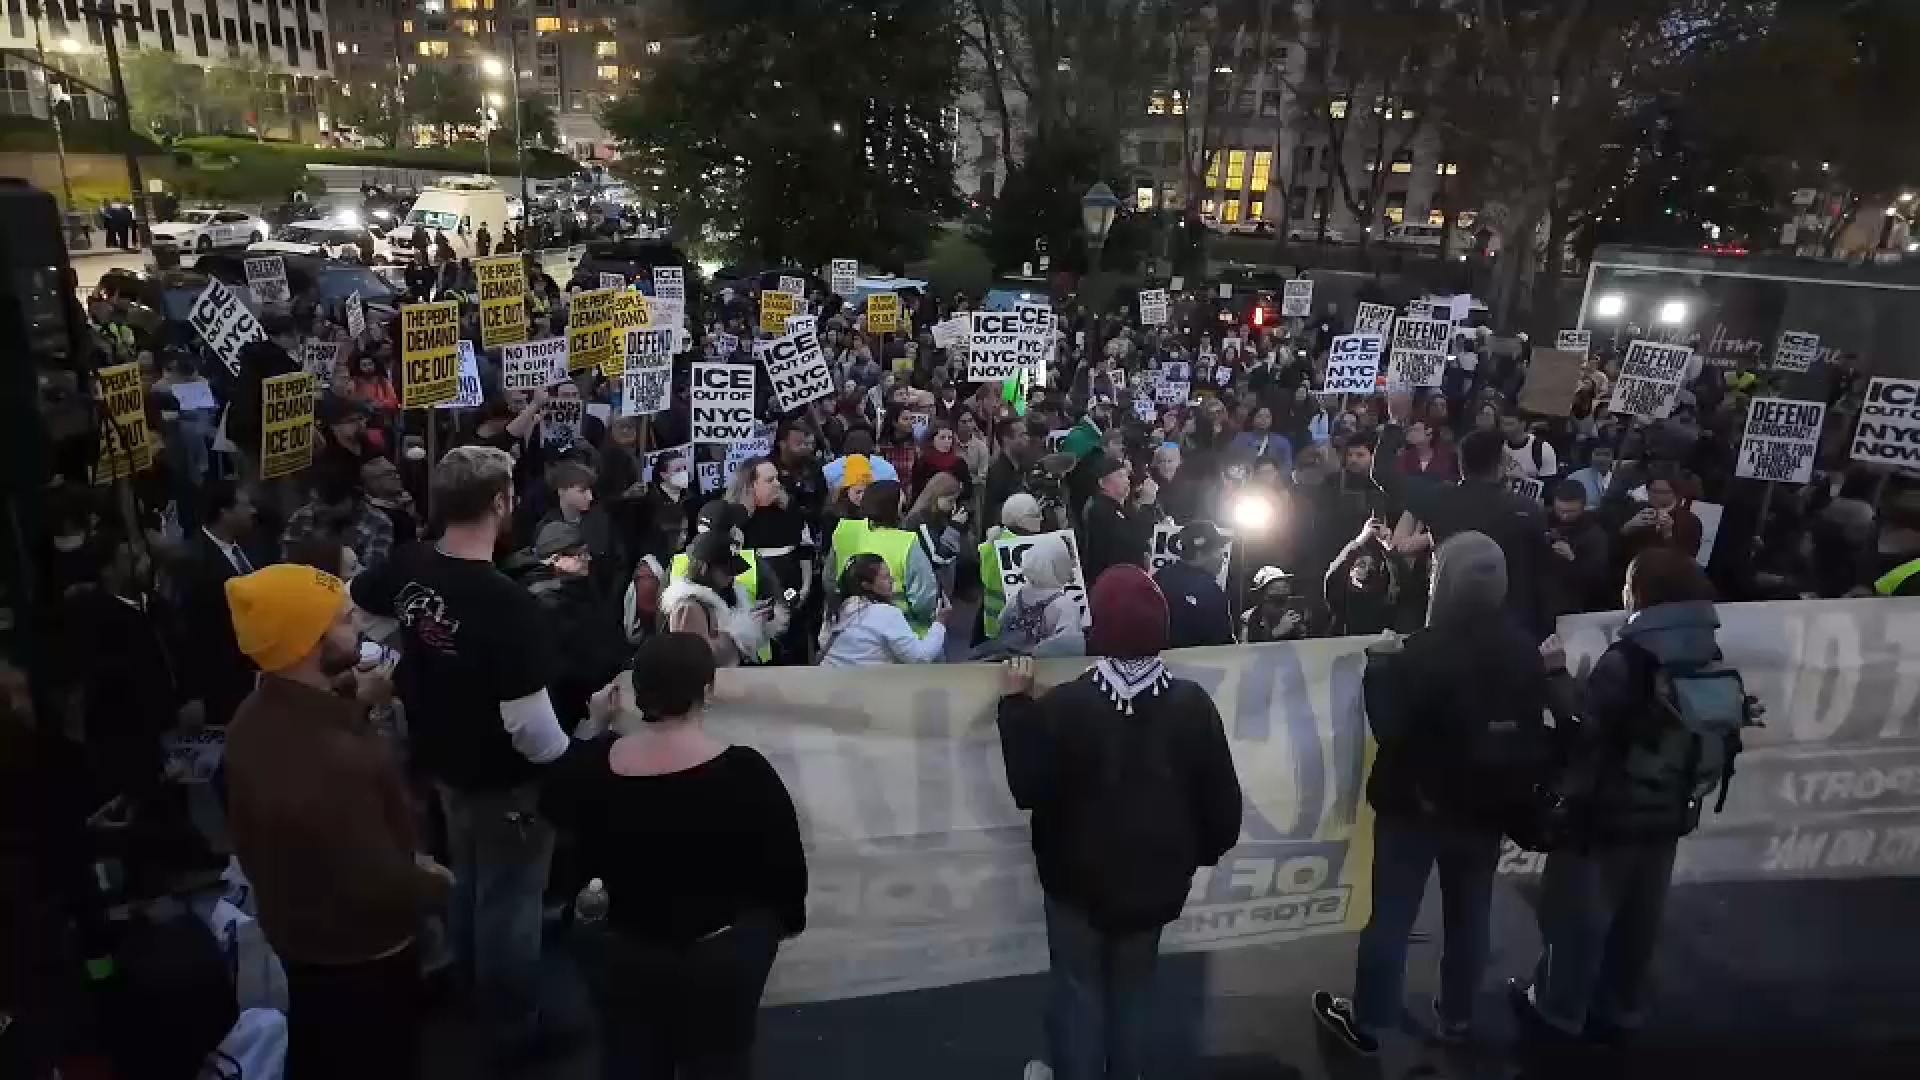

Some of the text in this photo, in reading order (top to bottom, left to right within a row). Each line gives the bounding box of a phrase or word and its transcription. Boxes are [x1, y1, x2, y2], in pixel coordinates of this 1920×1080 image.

[481, 279, 523, 301] DEMAND
[192, 282, 232, 332] ICE
[406, 304, 457, 328] THE PEOPLE
[483, 301, 523, 327] ICE OUT
[973, 316, 1018, 332] ICE
[1397, 321, 1448, 341] DEFEND
[406, 326, 457, 352] DEMAND
[505, 339, 566, 361] NO TROOPS
[628, 330, 672, 355] DEFEND
[763, 332, 817, 364] ICE
[974, 336, 1018, 344] OUT OF
[1333, 338, 1380, 353] ICE
[505, 361, 519, 373] IN
[769, 349, 820, 374] OUT OF
[972, 350, 1016, 363] NYC
[1629, 346, 1689, 370] DEFEND
[406, 357, 430, 385] ICE
[432, 354, 457, 381] OUT
[505, 372, 549, 387] CITIES!
[694, 368, 753, 389] ICE
[775, 366, 827, 391] NYC
[971, 366, 1014, 377] NOW
[1329, 366, 1375, 377] NYC
[781, 378, 829, 406] NOW
[1327, 378, 1374, 389] NOW
[1870, 382, 1920, 405] IC
[693, 391, 752, 401] OUT OF
[266, 395, 312, 423] DEMAND
[694, 408, 753, 423] NYC
[1752, 402, 1821, 427] DEFEND
[1865, 405, 1905, 418] OUT
[266, 424, 312, 454] ICE OUT
[694, 426, 751, 439] NOW
[1155, 531, 1187, 555] IC
